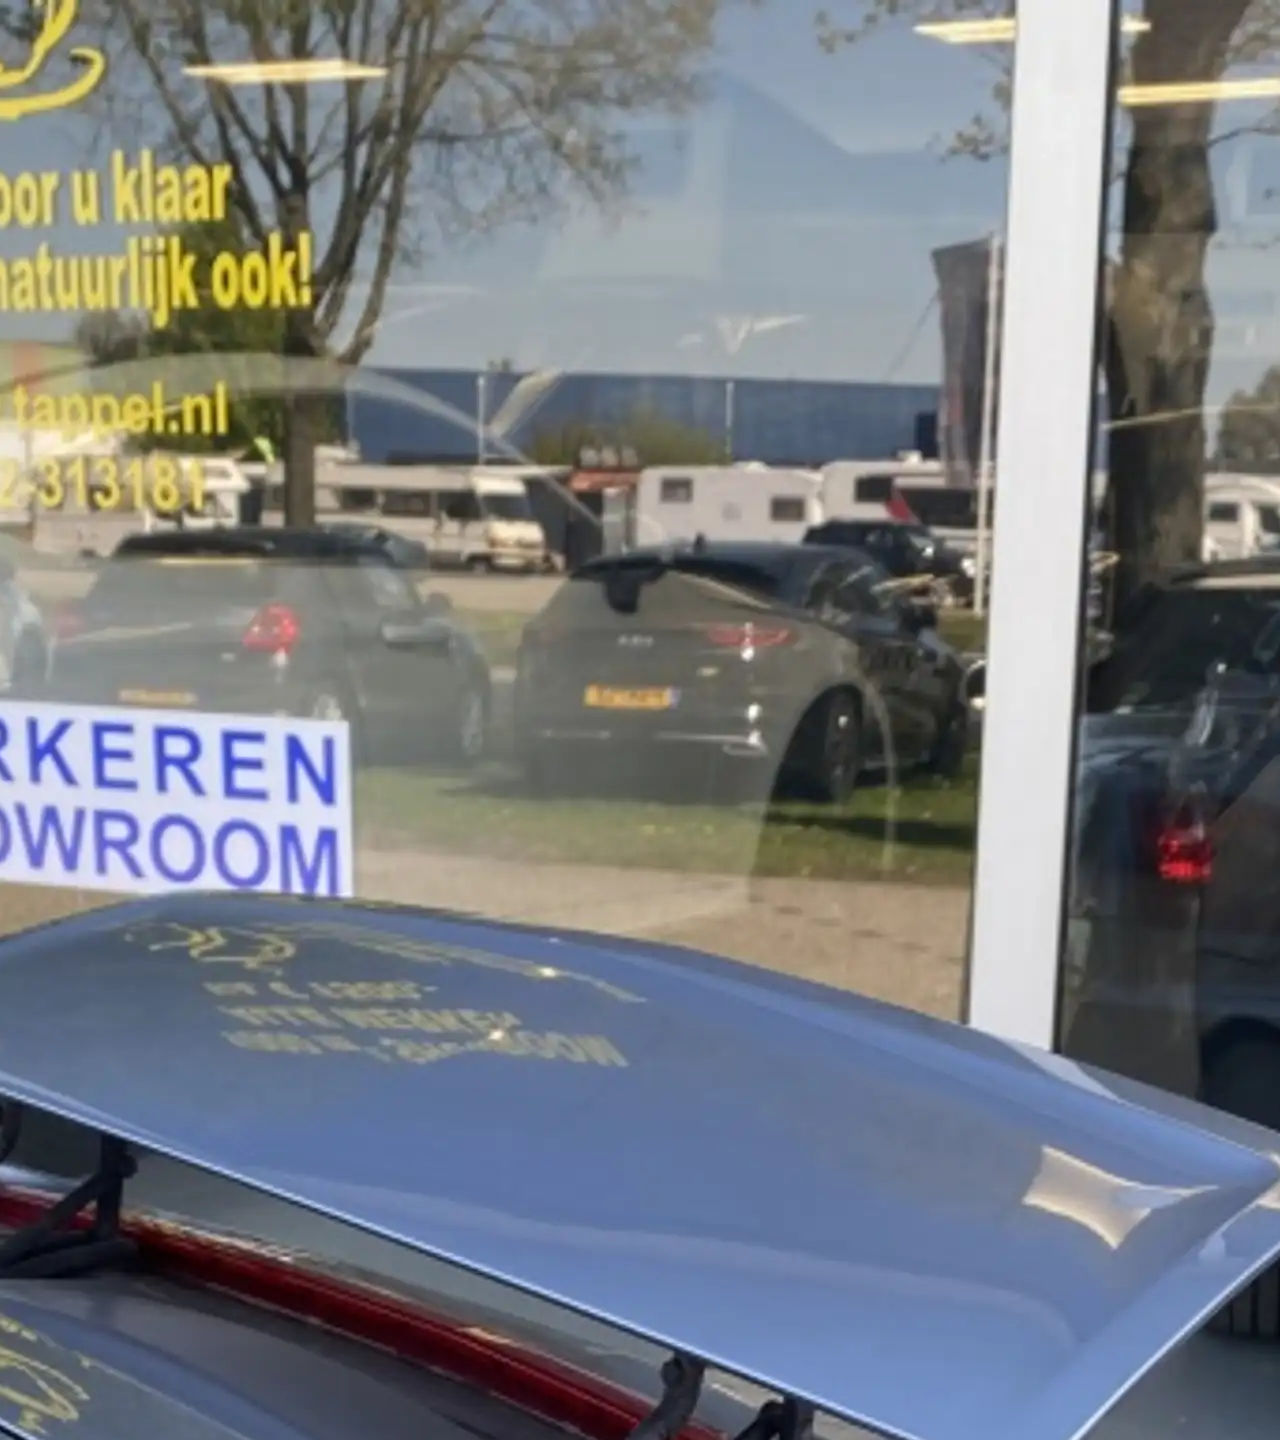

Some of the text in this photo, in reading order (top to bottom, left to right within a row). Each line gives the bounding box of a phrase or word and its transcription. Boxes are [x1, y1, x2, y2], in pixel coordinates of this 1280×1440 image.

[70, 168, 99, 226] u
[111, 149, 233, 222] klaar
[211, 231, 313, 310] ook!
